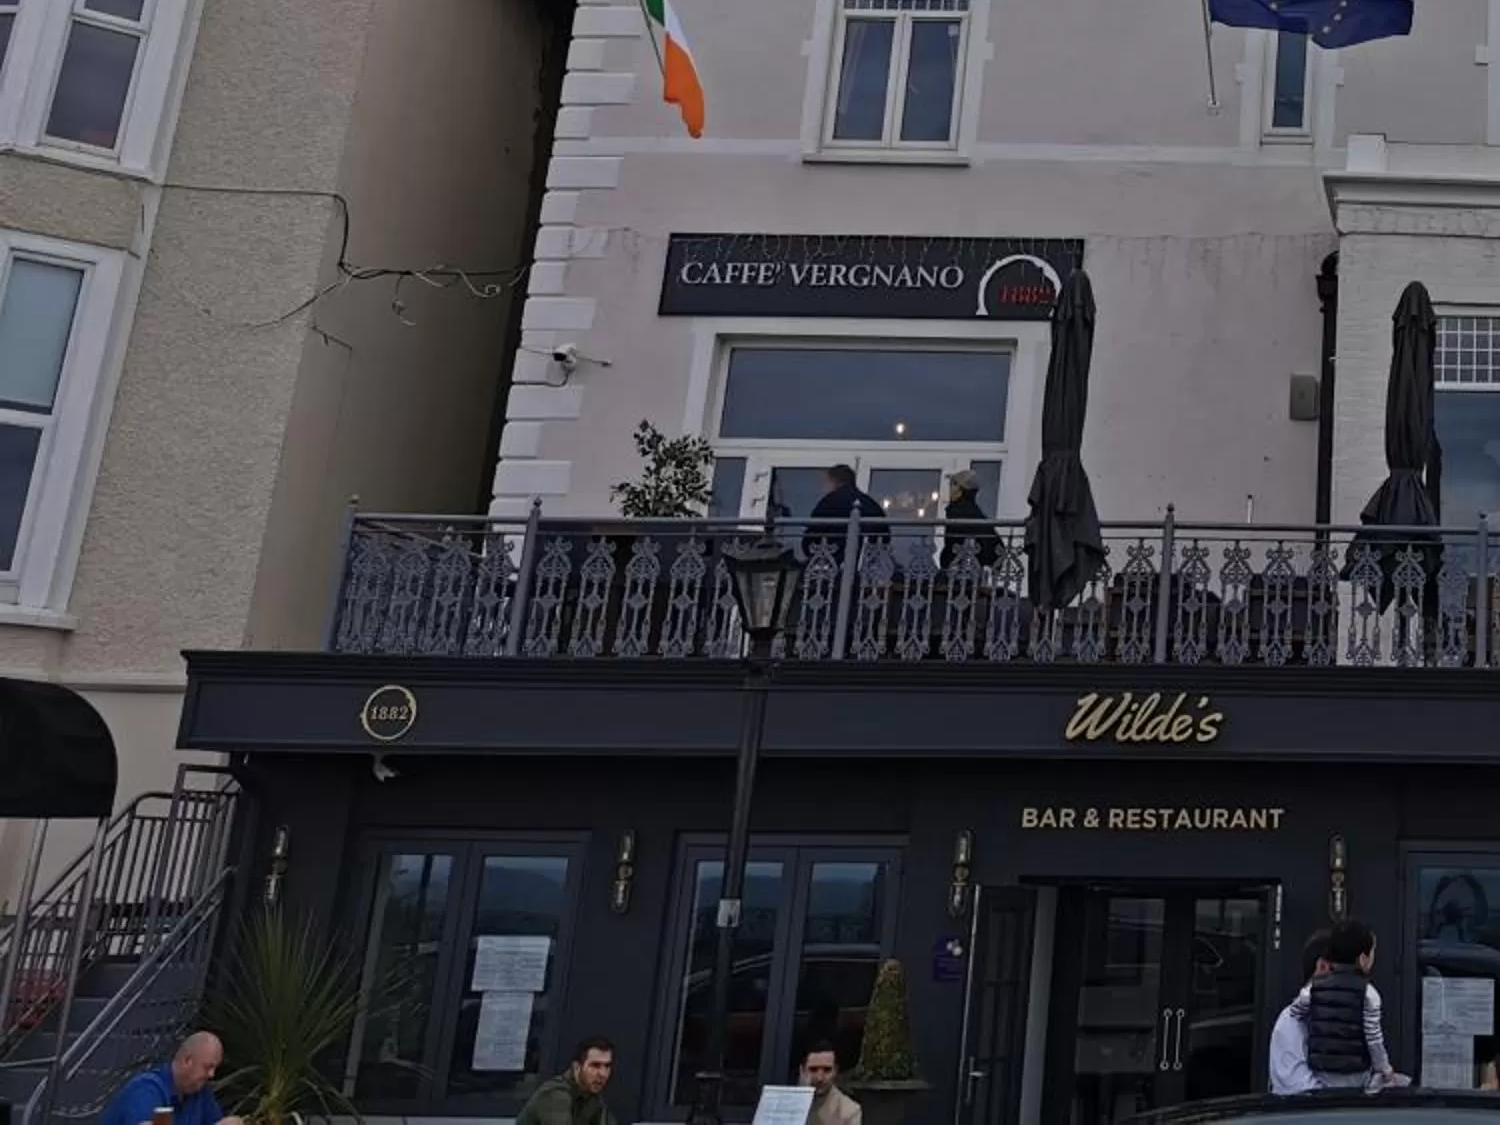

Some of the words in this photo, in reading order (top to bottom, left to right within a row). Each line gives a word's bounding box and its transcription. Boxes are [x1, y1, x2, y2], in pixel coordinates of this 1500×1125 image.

[790, 264, 964, 289] VERGNANO
[369, 705, 409, 721] 1882
[1065, 692, 1223, 742] Wilde's
[1021, 808, 1076, 828] BAR
[1083, 808, 1100, 828] &
[1108, 808, 1285, 829] RESTAURANT
